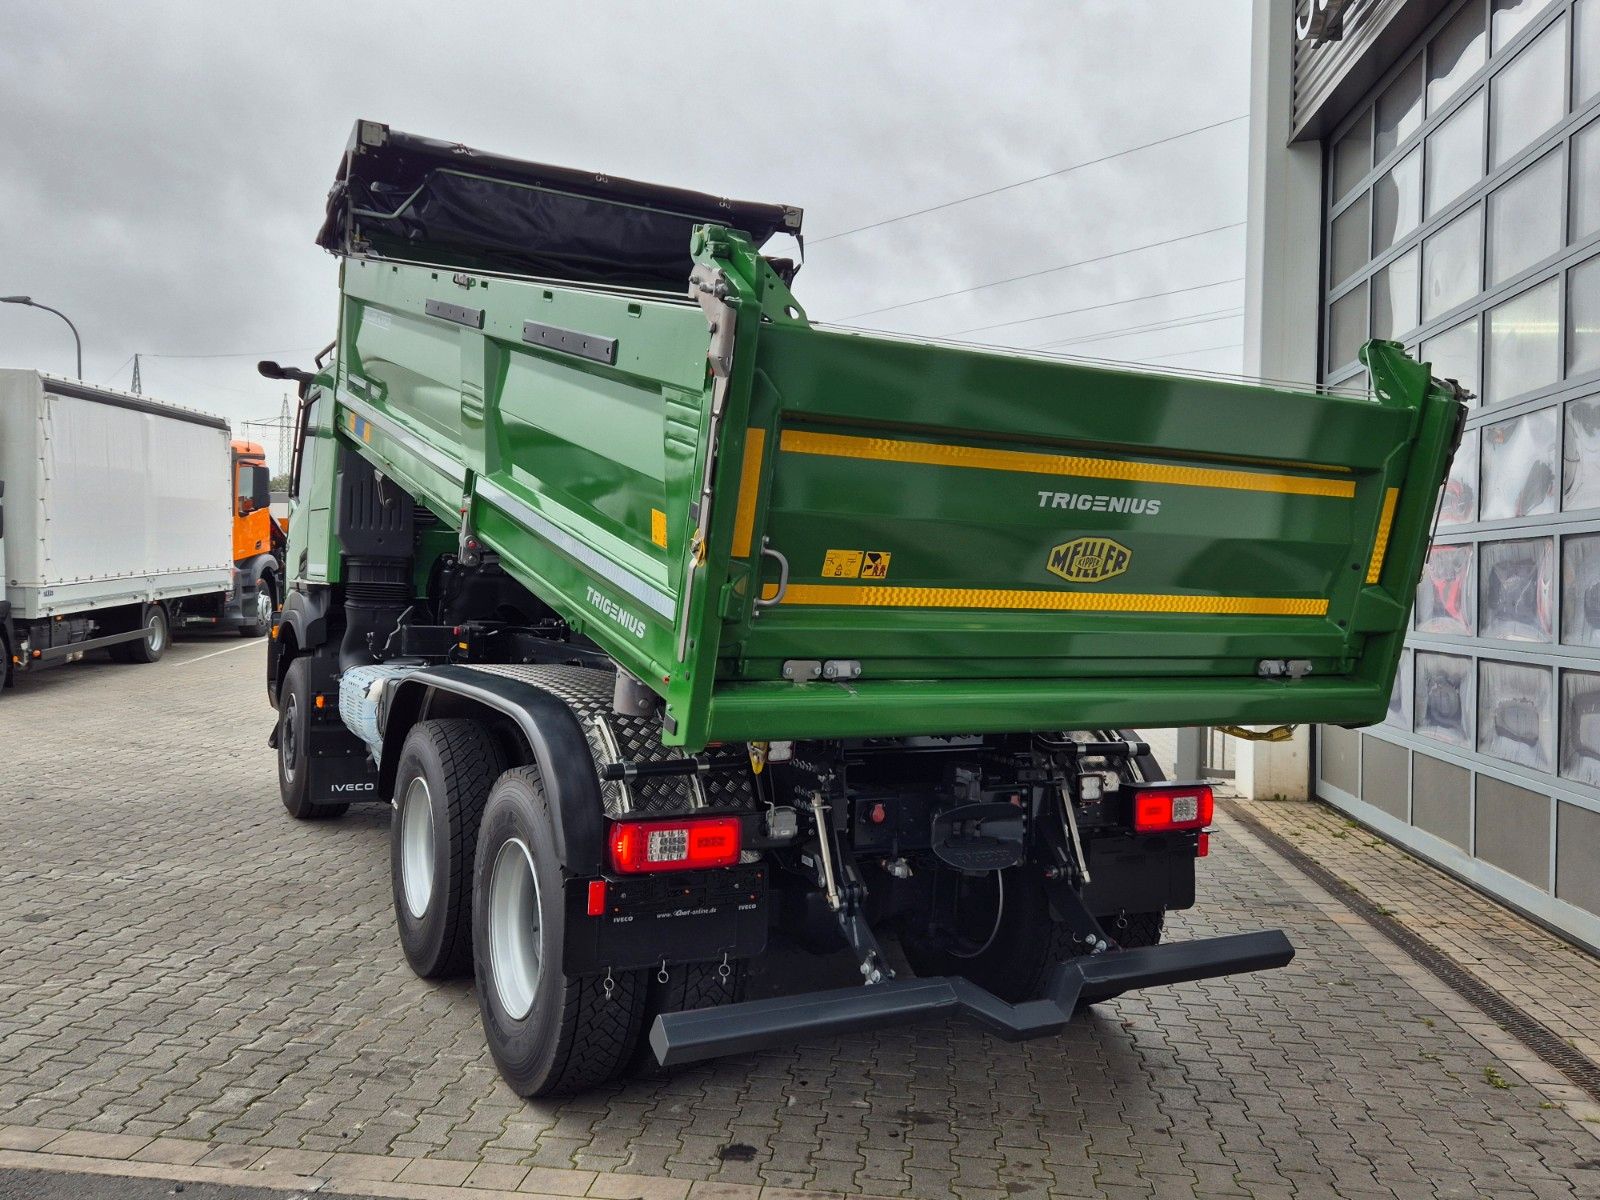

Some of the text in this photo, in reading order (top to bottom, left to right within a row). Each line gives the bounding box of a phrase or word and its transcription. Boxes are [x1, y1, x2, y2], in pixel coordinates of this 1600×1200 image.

[1037, 491, 1162, 515] TRIGENIUS
[1050, 541, 1128, 578] MEILLER
[586, 585, 646, 639] TRIGENIUS
[331, 783, 374, 792] IVECO
[738, 903, 757, 911] IVECO
[613, 915, 634, 923] IVECO
